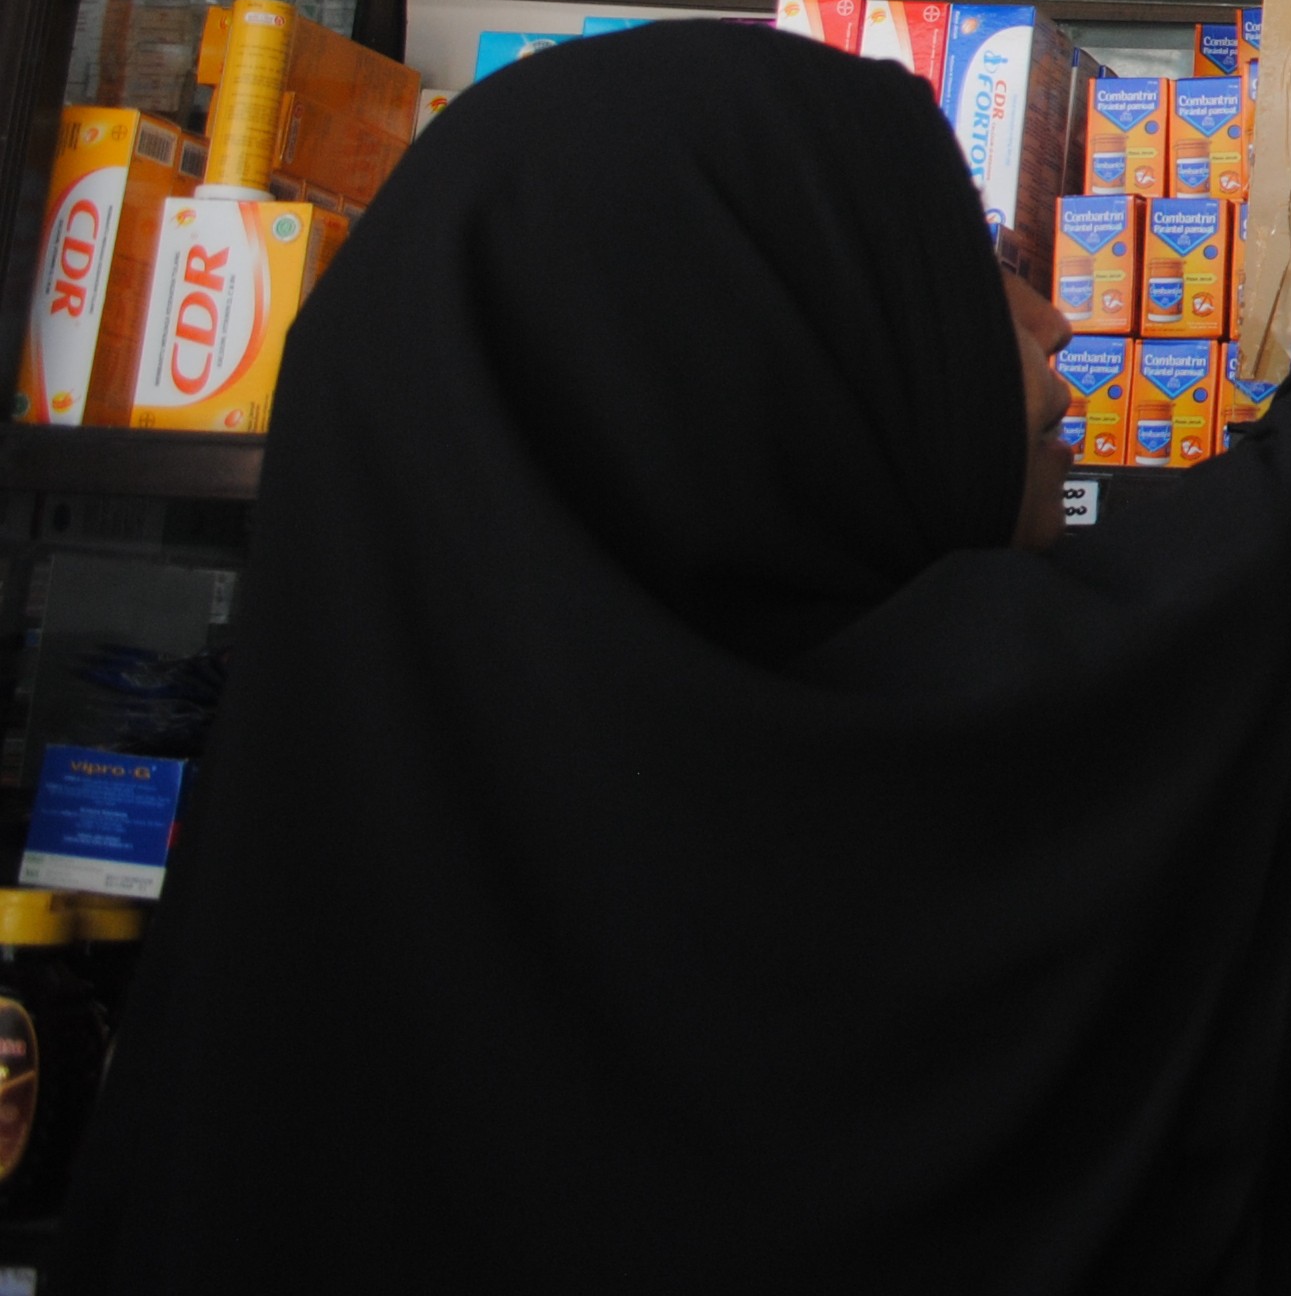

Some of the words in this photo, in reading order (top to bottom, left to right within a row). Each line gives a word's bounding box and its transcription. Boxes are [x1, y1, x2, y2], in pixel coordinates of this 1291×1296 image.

[1097, 89, 1157, 105] Combantrin
[1179, 94, 1239, 110] Combantrin
[1063, 210, 1125, 226] Combantrin
[49, 197, 100, 319] CDR
